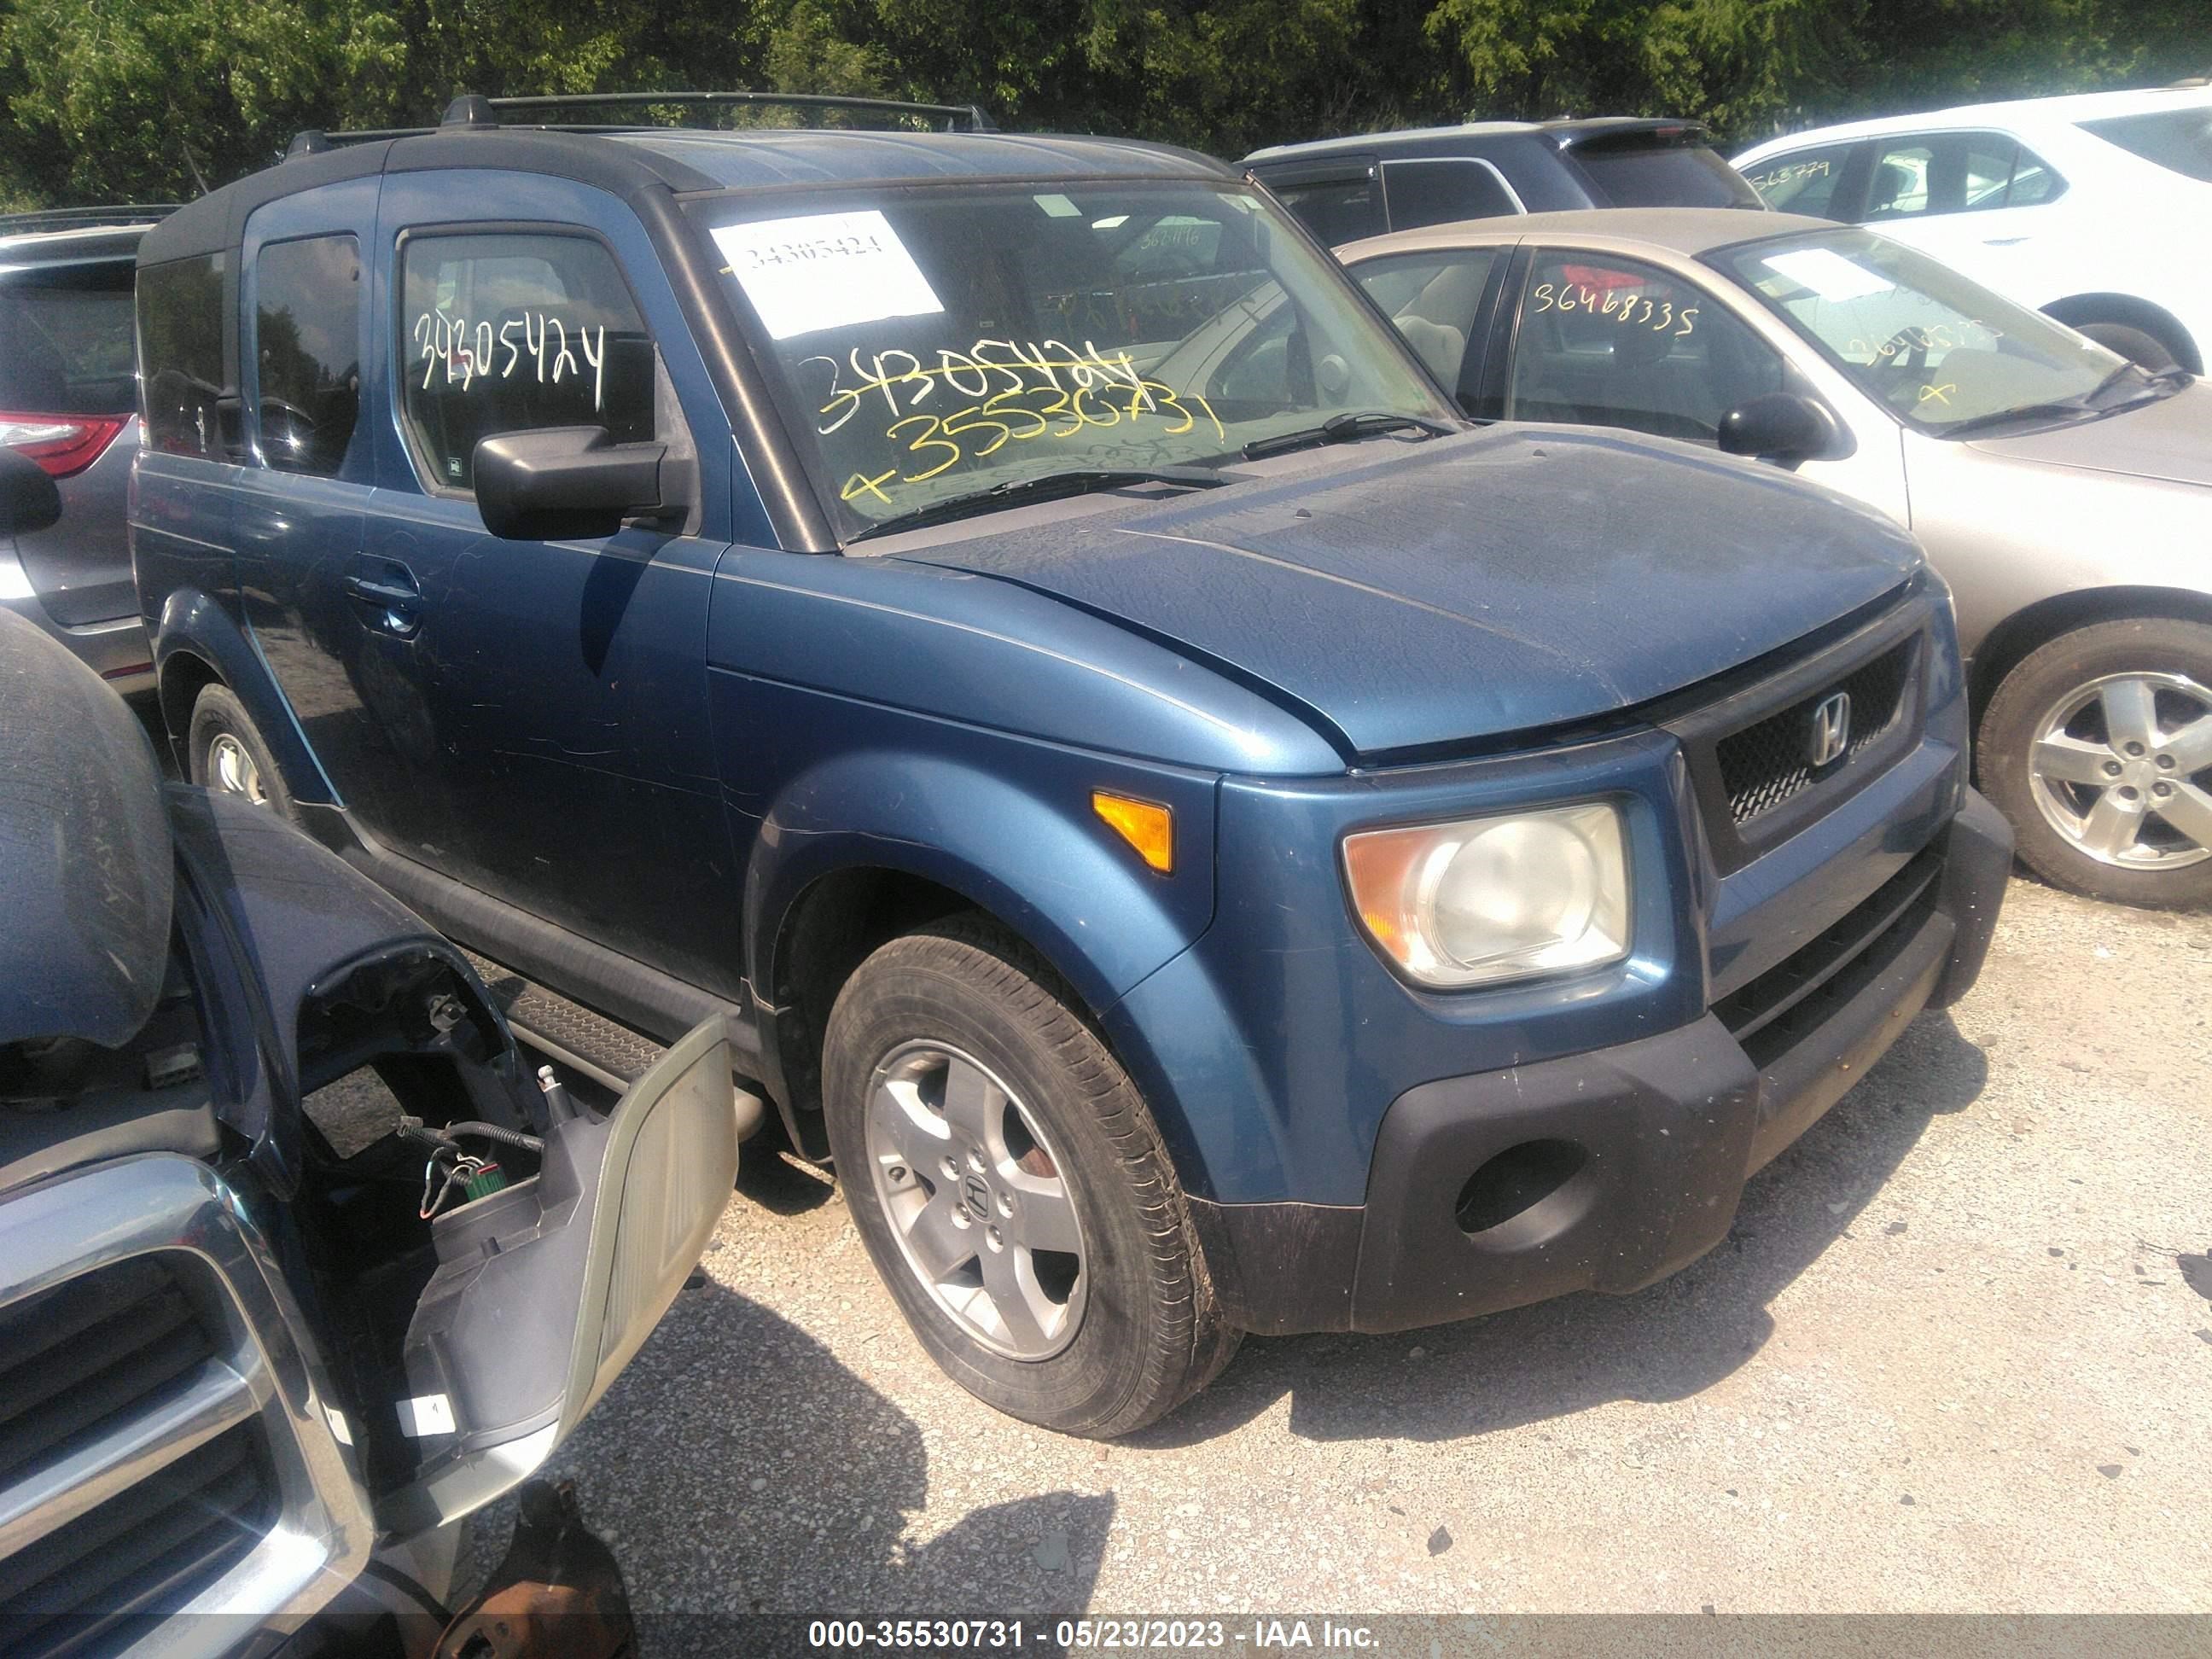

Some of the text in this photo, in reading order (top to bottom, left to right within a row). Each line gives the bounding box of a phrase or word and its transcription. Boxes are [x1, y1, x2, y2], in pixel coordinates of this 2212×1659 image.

[1534, 283, 1700, 336] 36468335
[414, 308, 604, 412] 34305424
[798, 339, 1157, 434] 34305424
